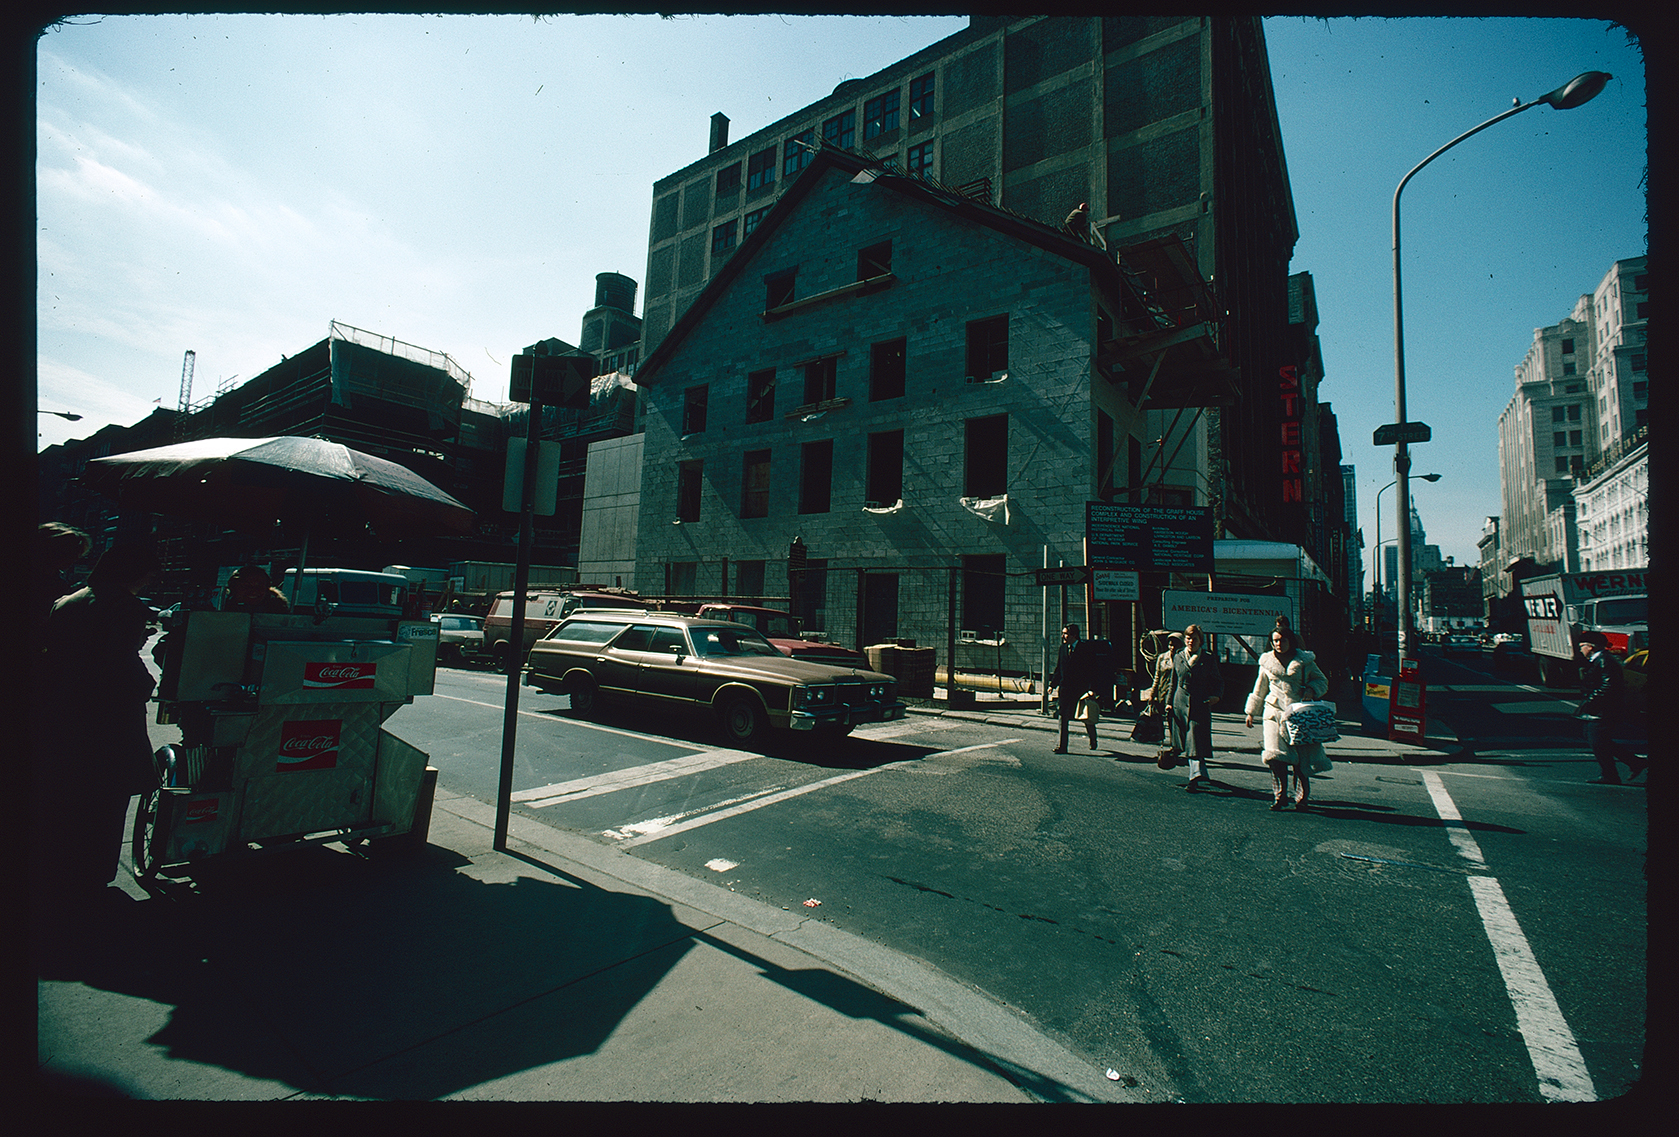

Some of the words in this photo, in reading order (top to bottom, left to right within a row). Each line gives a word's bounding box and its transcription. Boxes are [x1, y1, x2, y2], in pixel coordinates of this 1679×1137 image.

[545, 371, 567, 391] WAY
[1279, 365, 1301, 503] STERN
[1377, 432, 1395, 442] 7TH
[1398, 432, 1429, 441] STREET
[1091, 505, 1140, 513] RECONSTRUCTION
[1091, 516, 1129, 524] INTERPRETIVE
[1041, 573, 1055, 581] ONE
[1060, 572, 1075, 580] WAY
[1171, 605, 1218, 613] AMERICA'S
[1222, 607, 1286, 616] BICENTENNIAL
[411, 627, 437, 636] Fresca
[318, 666, 361, 678] Coca-Cola
[282, 735, 334, 751] Coca-Cola
[189, 805, 215, 815] Coca-Cola
